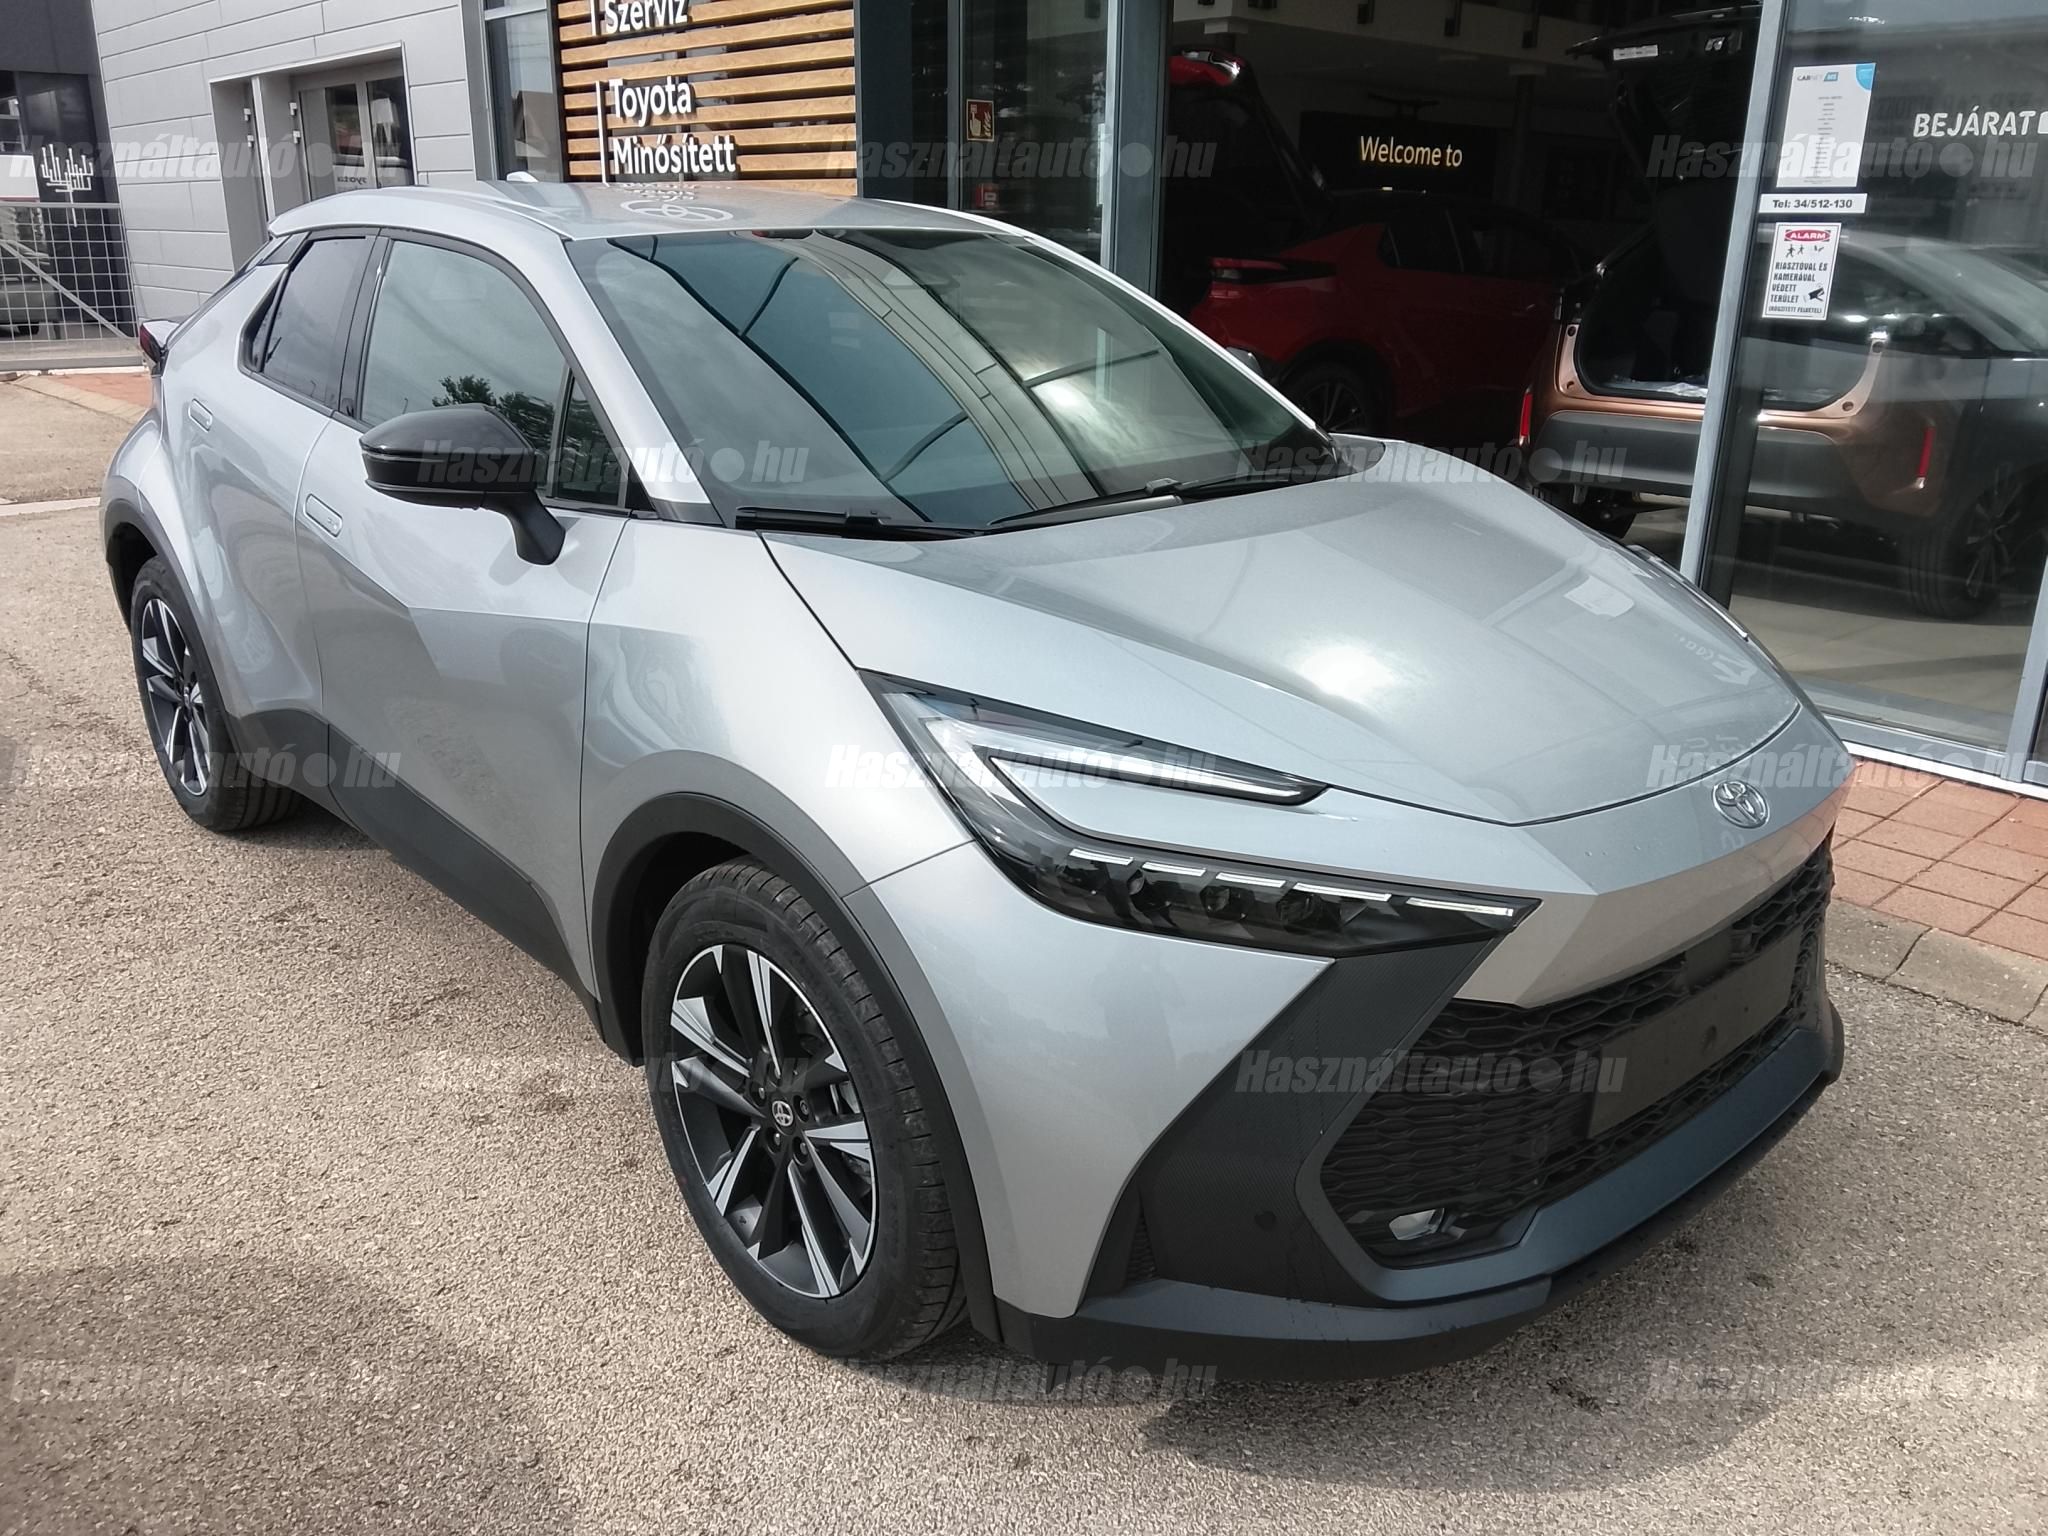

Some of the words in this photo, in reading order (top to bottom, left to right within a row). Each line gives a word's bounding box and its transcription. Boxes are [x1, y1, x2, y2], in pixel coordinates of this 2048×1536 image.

[605, 0, 688, 34] Szerviz
[608, 76, 692, 127] Toyota
[1913, 105, 2036, 138] BEJÁRAT
[613, 133, 737, 175] Minősített
[1361, 135, 1441, 166] Welcome
[1446, 144, 1463, 167] to
[1773, 199, 1792, 208] Tel:
[1794, 199, 1853, 209] 34/512-130
[1790, 231, 1826, 240] ALARM
[1773, 272, 1816, 281] KAMERÁVAL
[1818, 261, 1828, 271] ÉS
[1772, 283, 1797, 292] VÉDETT
